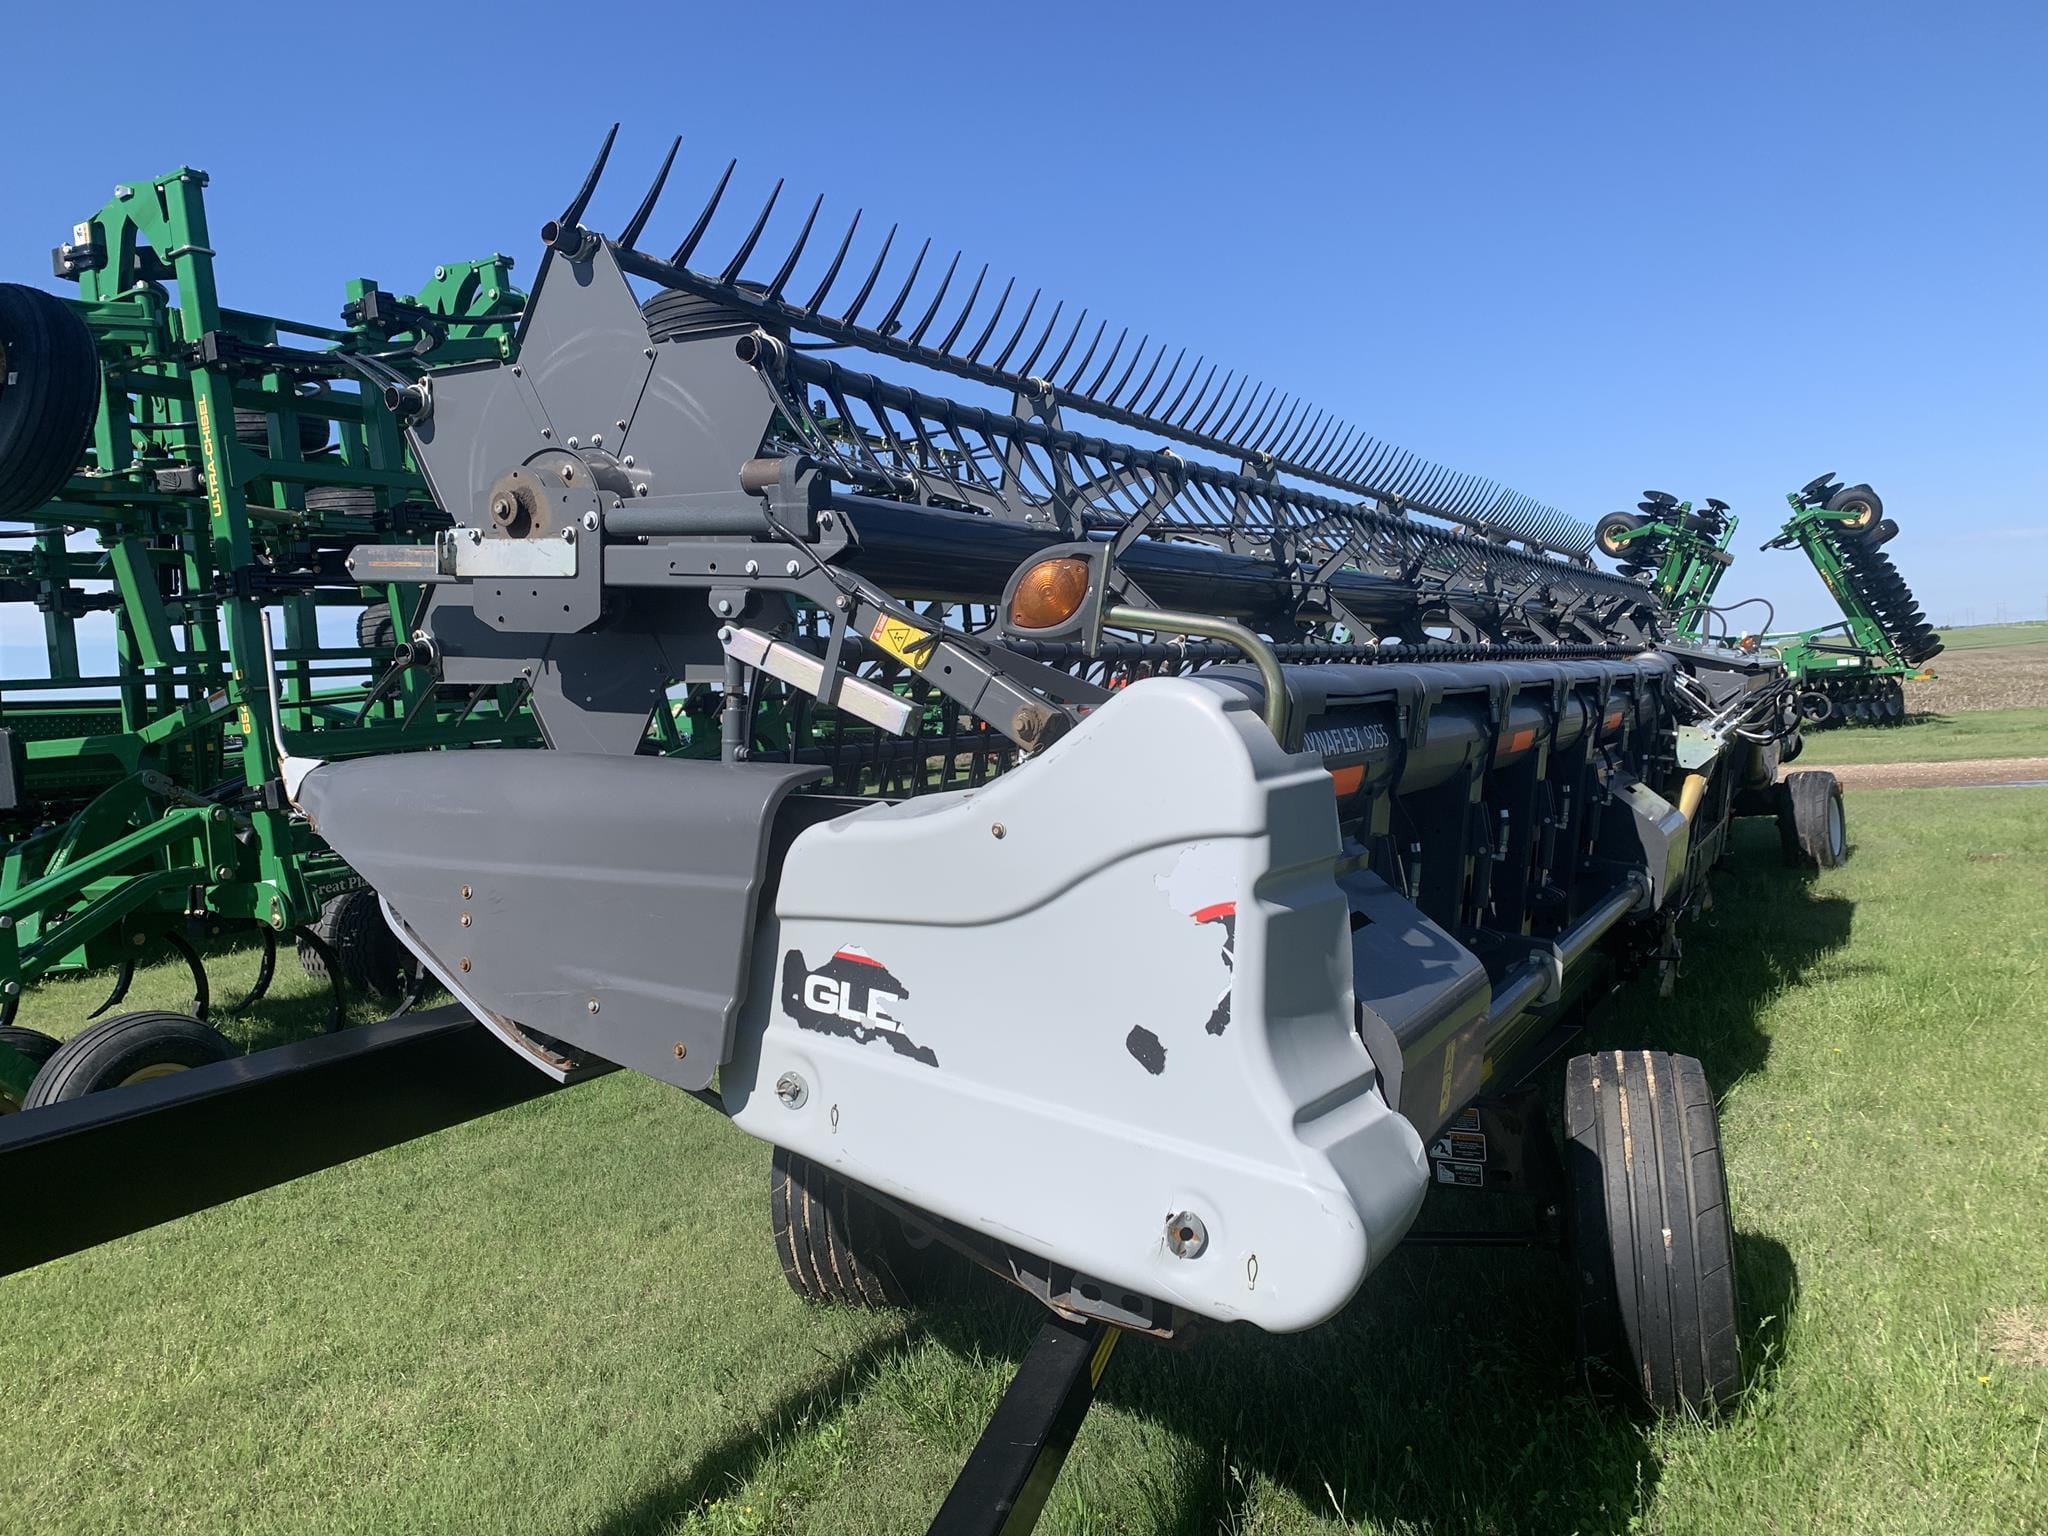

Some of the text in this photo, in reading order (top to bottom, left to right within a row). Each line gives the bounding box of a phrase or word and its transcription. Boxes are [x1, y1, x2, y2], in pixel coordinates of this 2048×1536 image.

[198, 393, 223, 517] ULTRA-CHISEL
[1363, 724, 1389, 749] 9255
[804, 974, 907, 1035] GLE
